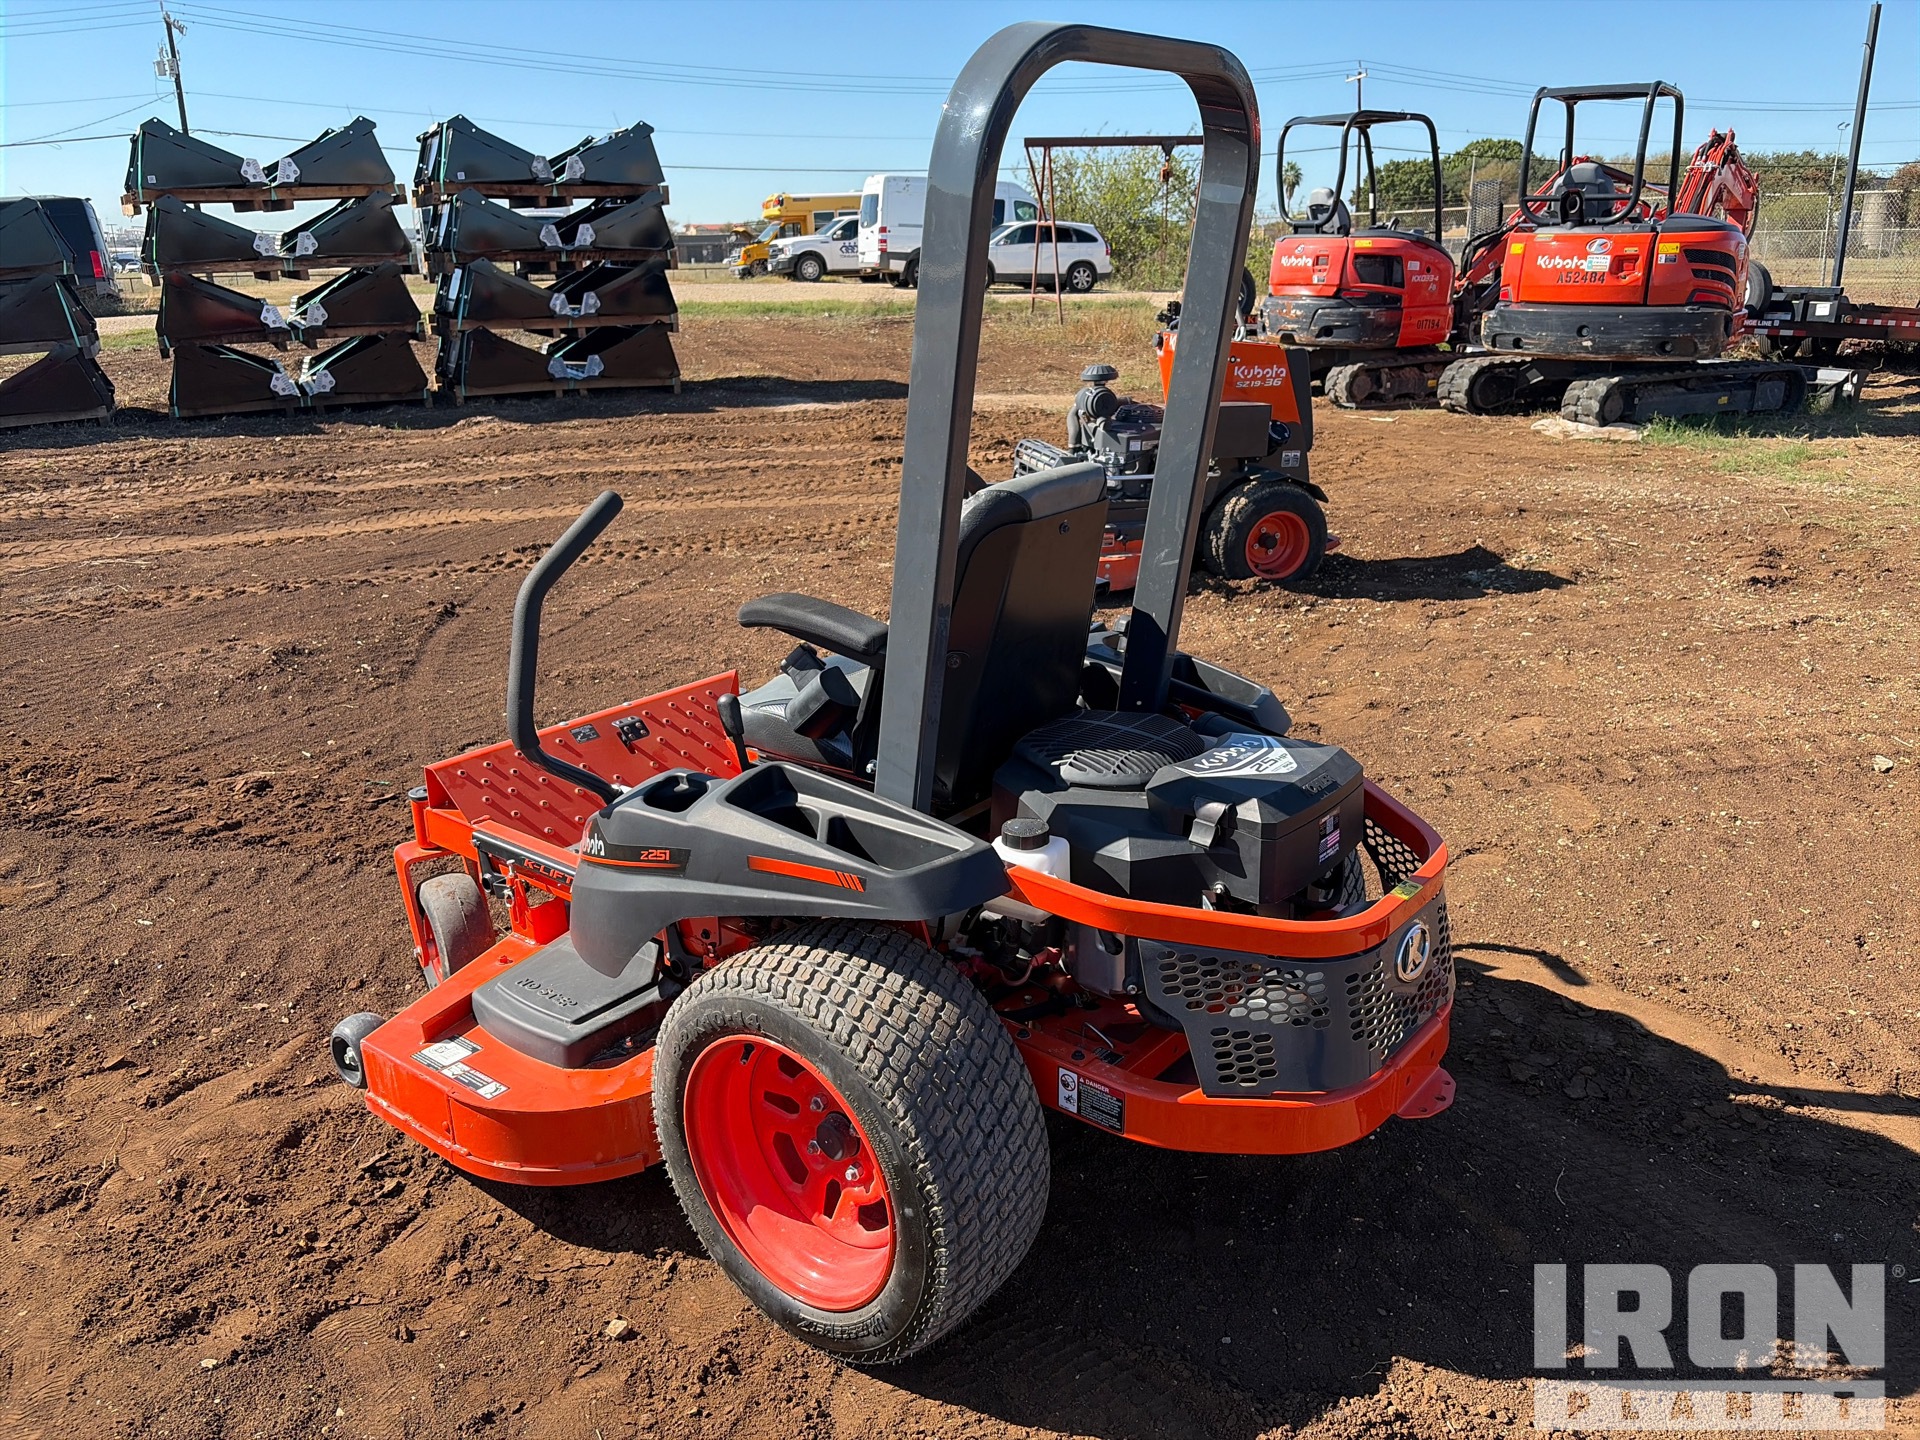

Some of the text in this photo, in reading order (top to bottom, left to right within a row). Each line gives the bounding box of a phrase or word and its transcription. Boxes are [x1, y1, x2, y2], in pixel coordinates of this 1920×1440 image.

[1281, 255, 1312, 267] Kubota
[1537, 255, 1586, 270] Kubota
[1557, 271, 1606, 284] A52484
[1417, 318, 1441, 330] 017194
[1234, 365, 1287, 379] Kubota
[1194, 740, 1261, 769] Kubota
[1250, 757, 1279, 773] 25
[523, 858, 574, 885] K-LIFT
[514, 977, 542, 991] NO
[1085, 1079, 1110, 1094] DANGER
